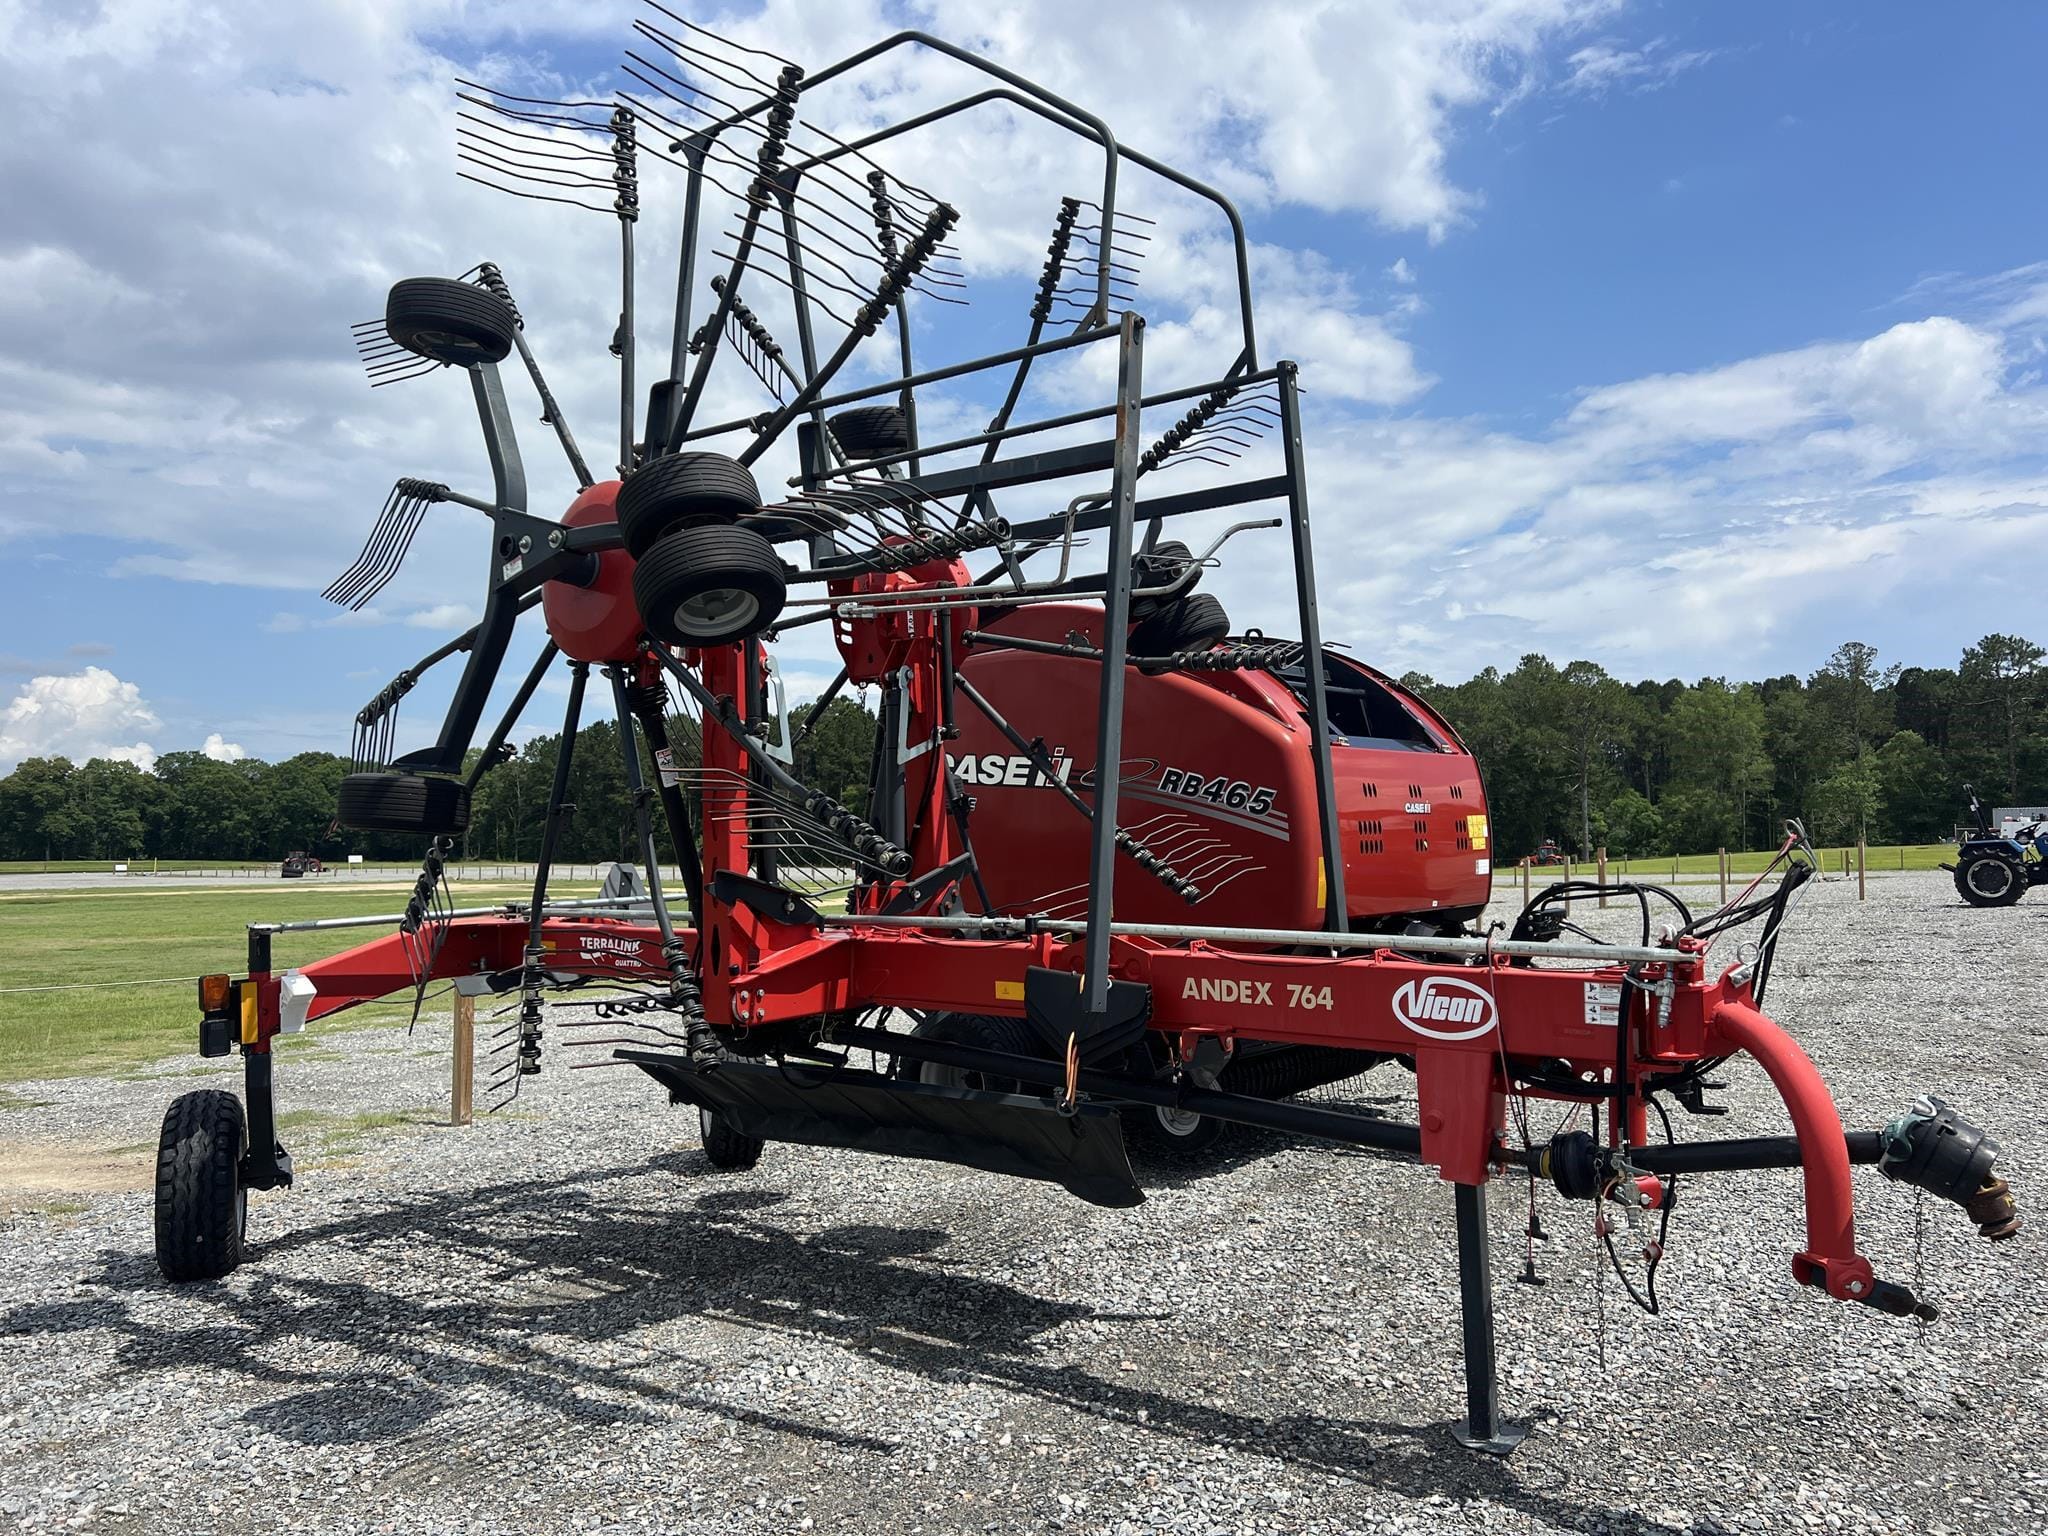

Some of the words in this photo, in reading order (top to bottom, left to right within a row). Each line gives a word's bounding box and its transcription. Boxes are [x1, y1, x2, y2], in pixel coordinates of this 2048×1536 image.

[1157, 766, 1277, 816] RB465
[1405, 802, 1425, 813] CASE
[579, 936, 641, 952] TERRALINK
[1182, 977, 1273, 1006] ANDEX
[1286, 983, 1334, 1011] 764
[1407, 979, 1484, 1024] Vicon
